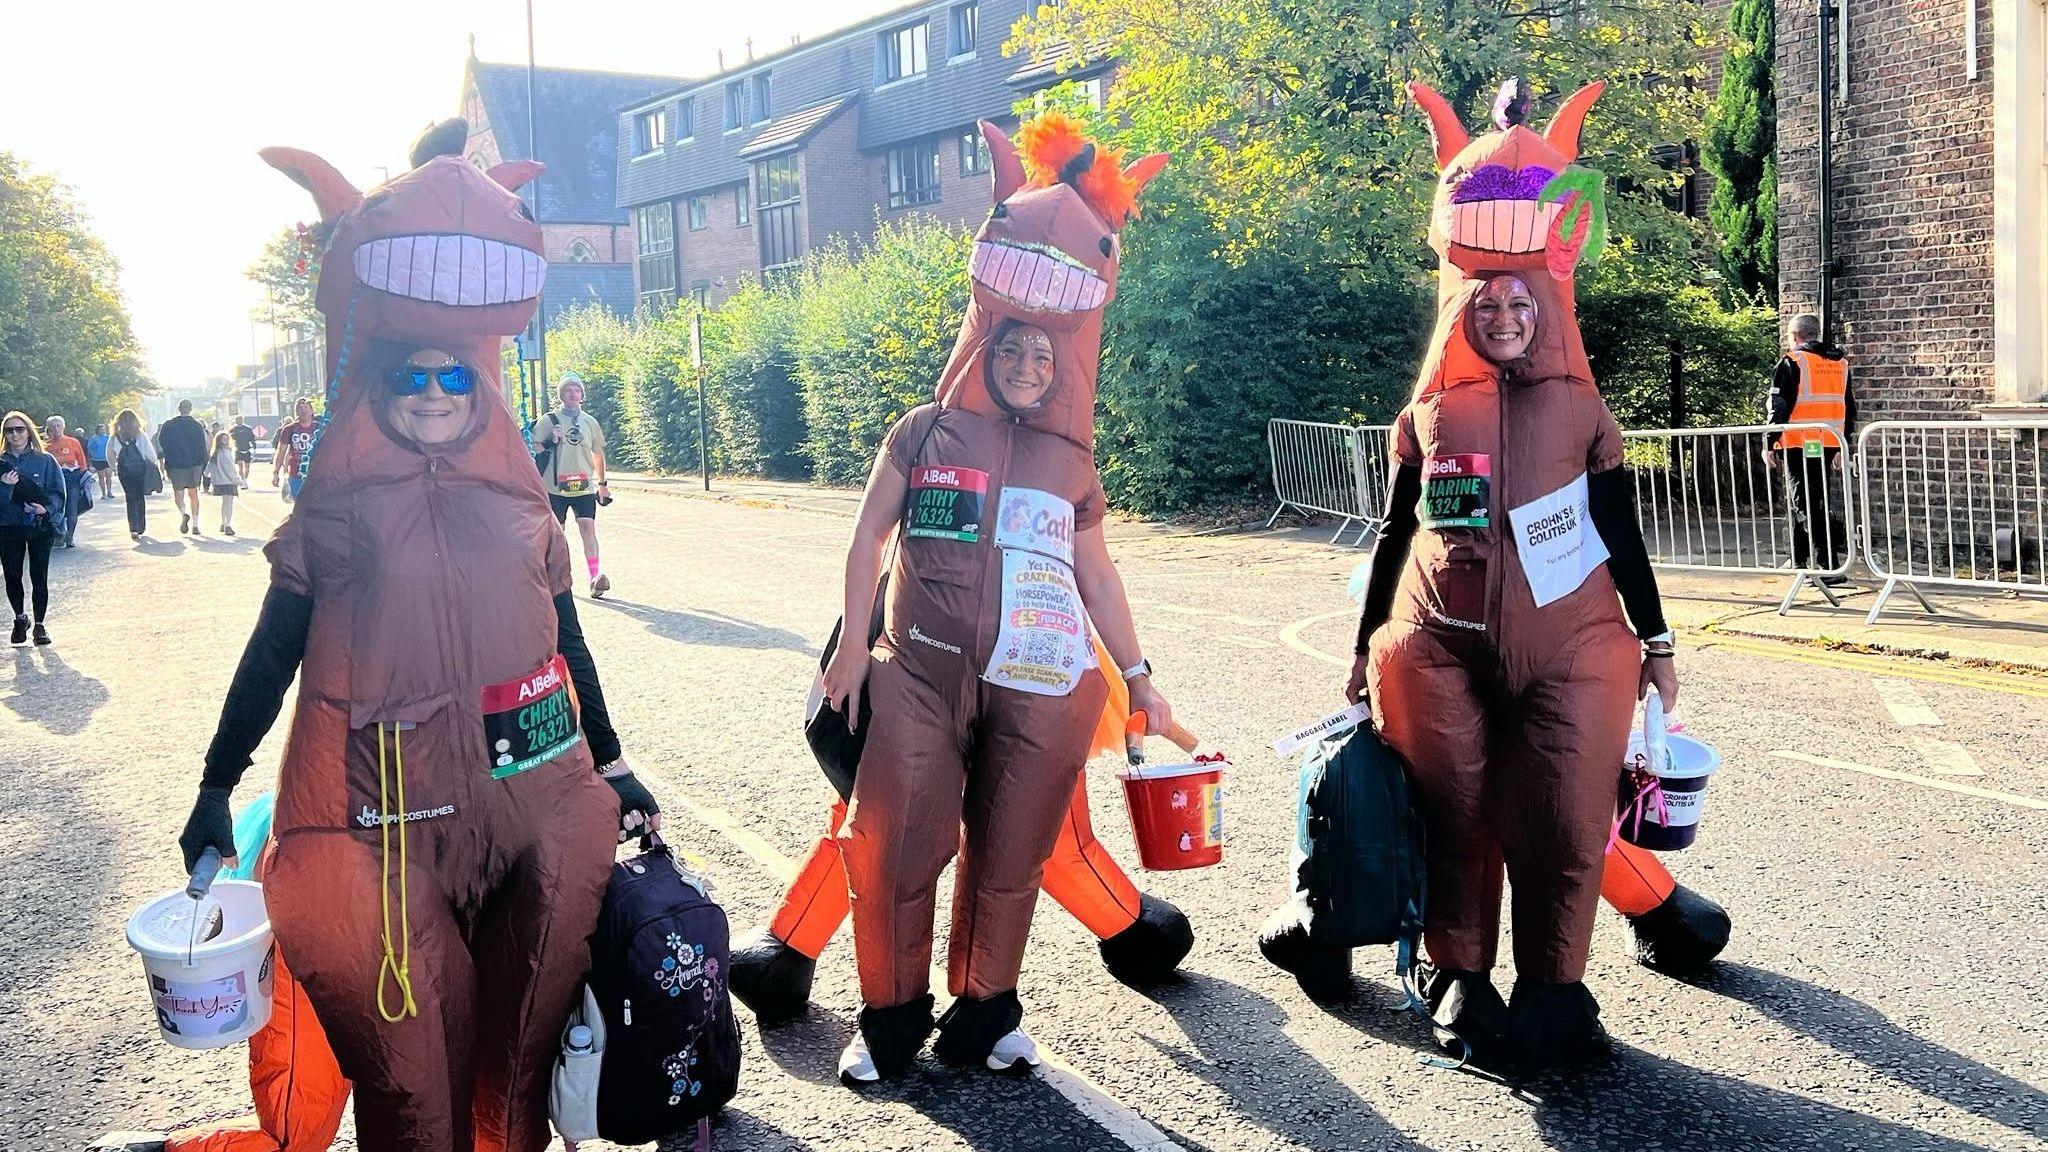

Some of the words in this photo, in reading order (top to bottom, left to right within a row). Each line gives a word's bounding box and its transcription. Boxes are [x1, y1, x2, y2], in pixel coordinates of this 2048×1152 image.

[292, 433, 310, 443] GO
[1427, 478, 1481, 498] HARINE
[919, 490, 959, 507] CATHY
[1426, 497, 1461, 516] 6324
[915, 507, 954, 526] 26326
[1526, 508, 1570, 535] CROHN'S
[1529, 523, 1567, 547] COLITIS
[1566, 517, 1577, 531] UK
[1028, 560, 1043, 571] Yes
[1017, 571, 1047, 584] CRAZY
[527, 711, 572, 753] 26321
[1295, 723, 1327, 741] BAGGAGE
[1327, 713, 1348, 727] LABEL
[518, 756, 541, 770] GREAT
[164, 996, 199, 1016] Thank
[201, 995, 229, 1019] You
